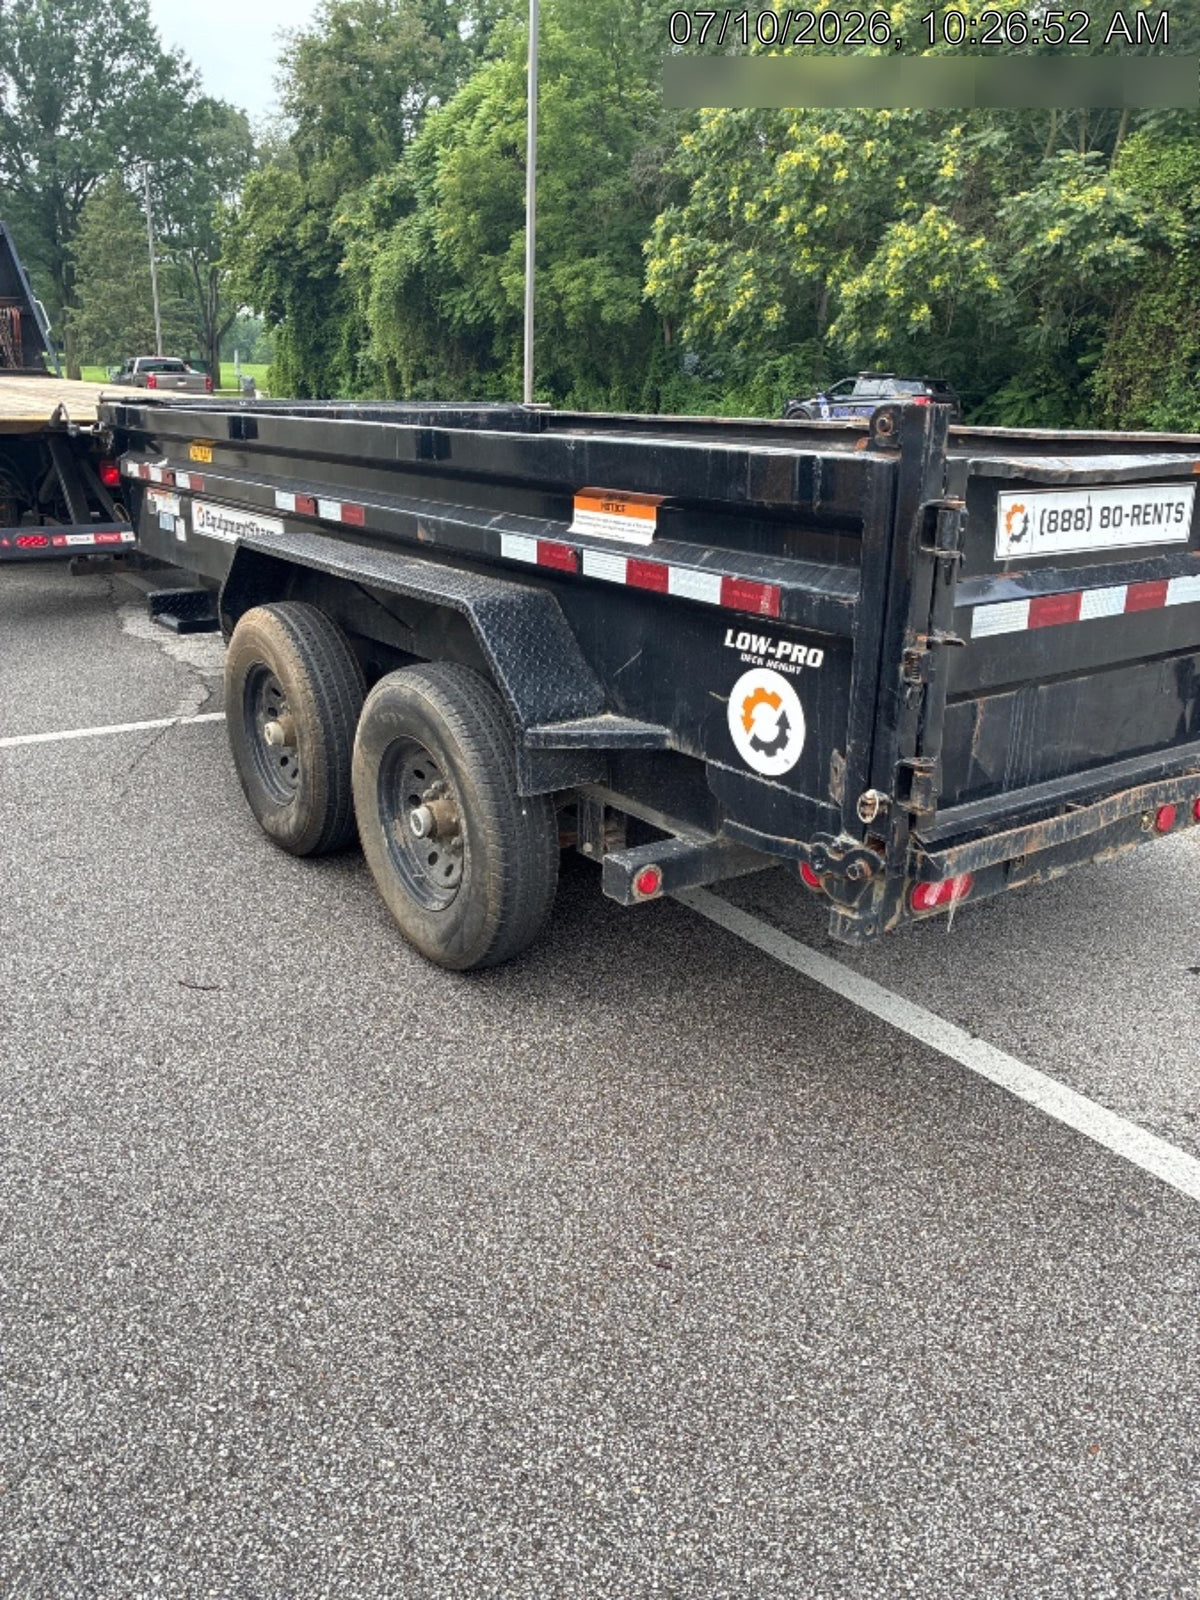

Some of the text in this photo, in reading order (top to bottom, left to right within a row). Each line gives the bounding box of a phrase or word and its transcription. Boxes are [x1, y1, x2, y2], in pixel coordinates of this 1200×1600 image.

[1039, 501, 1186, 536] (888) 80-RENTS
[723, 628, 824, 668] LOW-PRO
[740, 652, 803, 675] DECK HEIGHT
